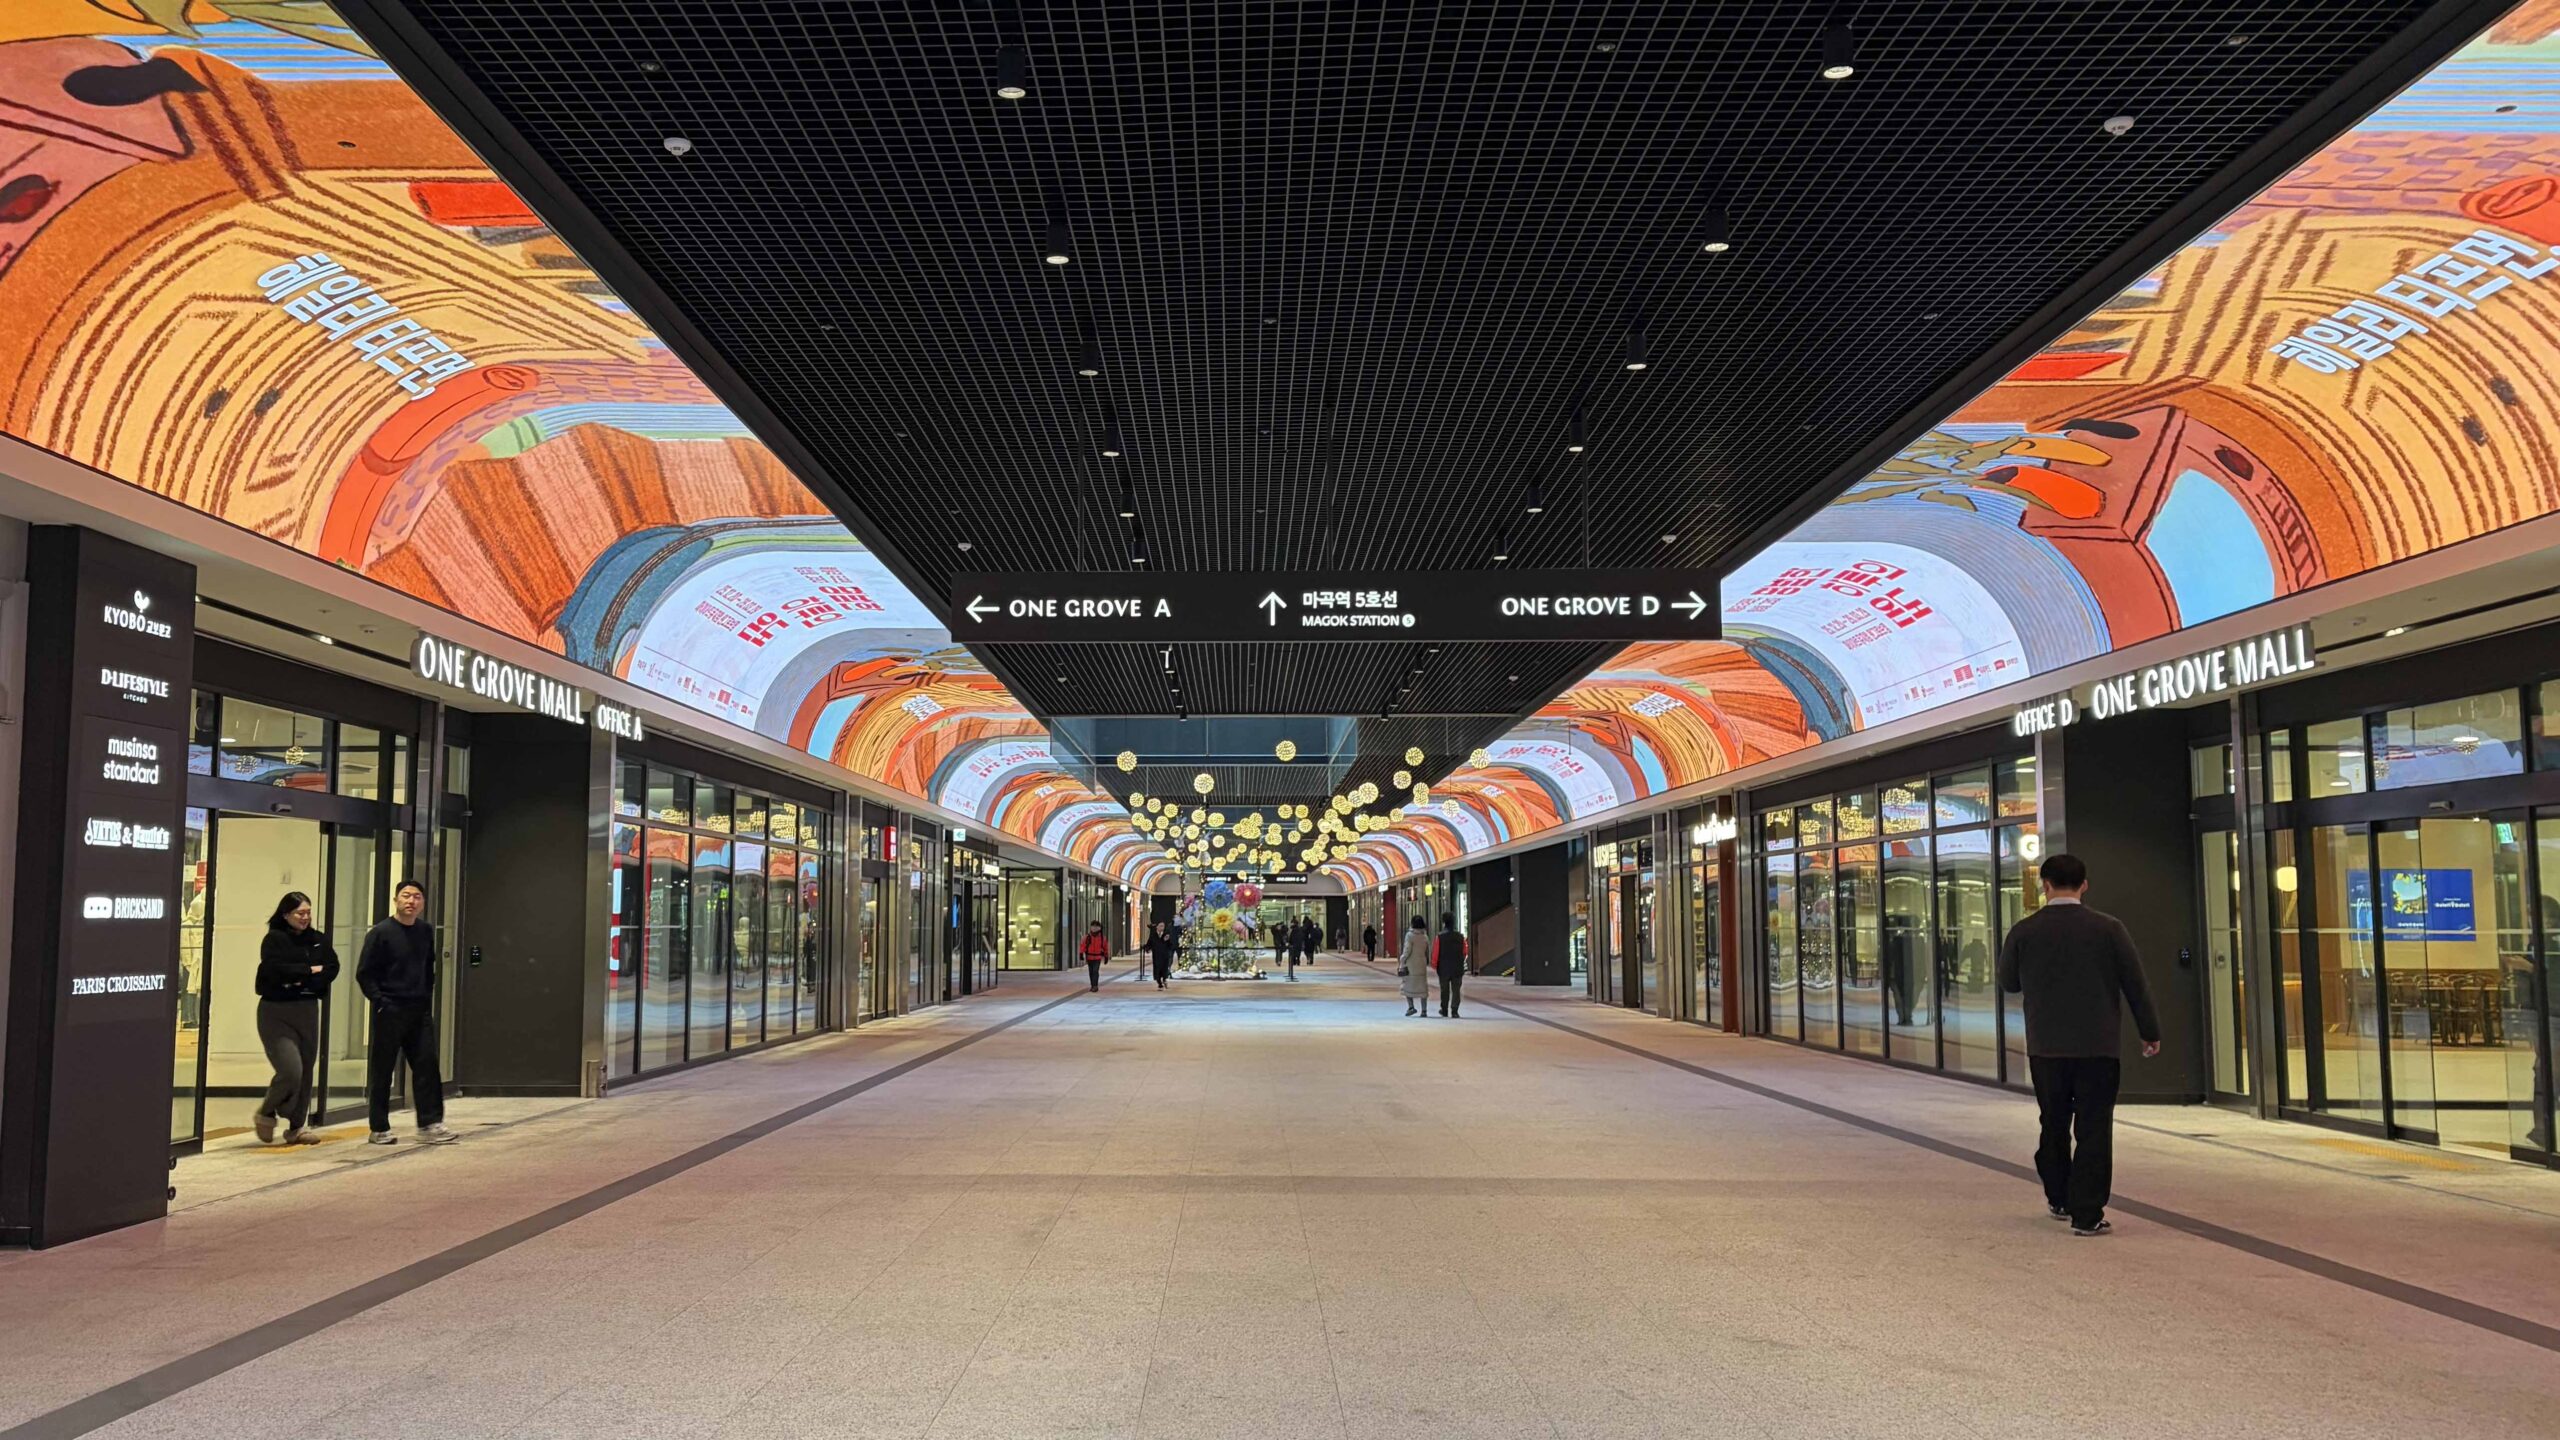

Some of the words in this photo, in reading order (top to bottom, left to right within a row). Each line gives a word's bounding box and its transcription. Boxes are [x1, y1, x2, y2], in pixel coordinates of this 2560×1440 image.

[257, 252, 400, 341] 헤일리
[2269, 300, 2429, 374] 헤일리
[1009, 599, 1057, 618] ONE
[1065, 599, 1142, 618] GROVE
[1154, 599, 1172, 618] A
[1303, 591, 1350, 609] 마곡역
[1355, 591, 1398, 609] 5호선
[1502, 597, 1549, 616] ONE
[1554, 596, 1631, 615] GROVE
[1642, 596, 1660, 615] D
[104, 605, 146, 632] KYOBO
[1303, 615, 1349, 627] MAGOK
[1350, 615, 1400, 627] STATION
[419, 636, 465, 689] ONE
[471, 655, 536, 710] GROVE
[540, 678, 585, 725] MALL
[2093, 676, 2137, 720] ONE
[2145, 649, 2228, 708] GROVE
[2235, 628, 2315, 686] MALL
[597, 704, 632, 738] OFFICE
[633, 716, 643, 742] A
[2014, 705, 2056, 738] OFFICE
[2061, 698, 2073, 727] D
[107, 736, 157, 761] musinsa
[103, 760, 159, 785] standard
[114, 897, 163, 919] BRICKSAND
[72, 976, 105, 995] PARIS
[107, 974, 166, 993] CROISSANT
